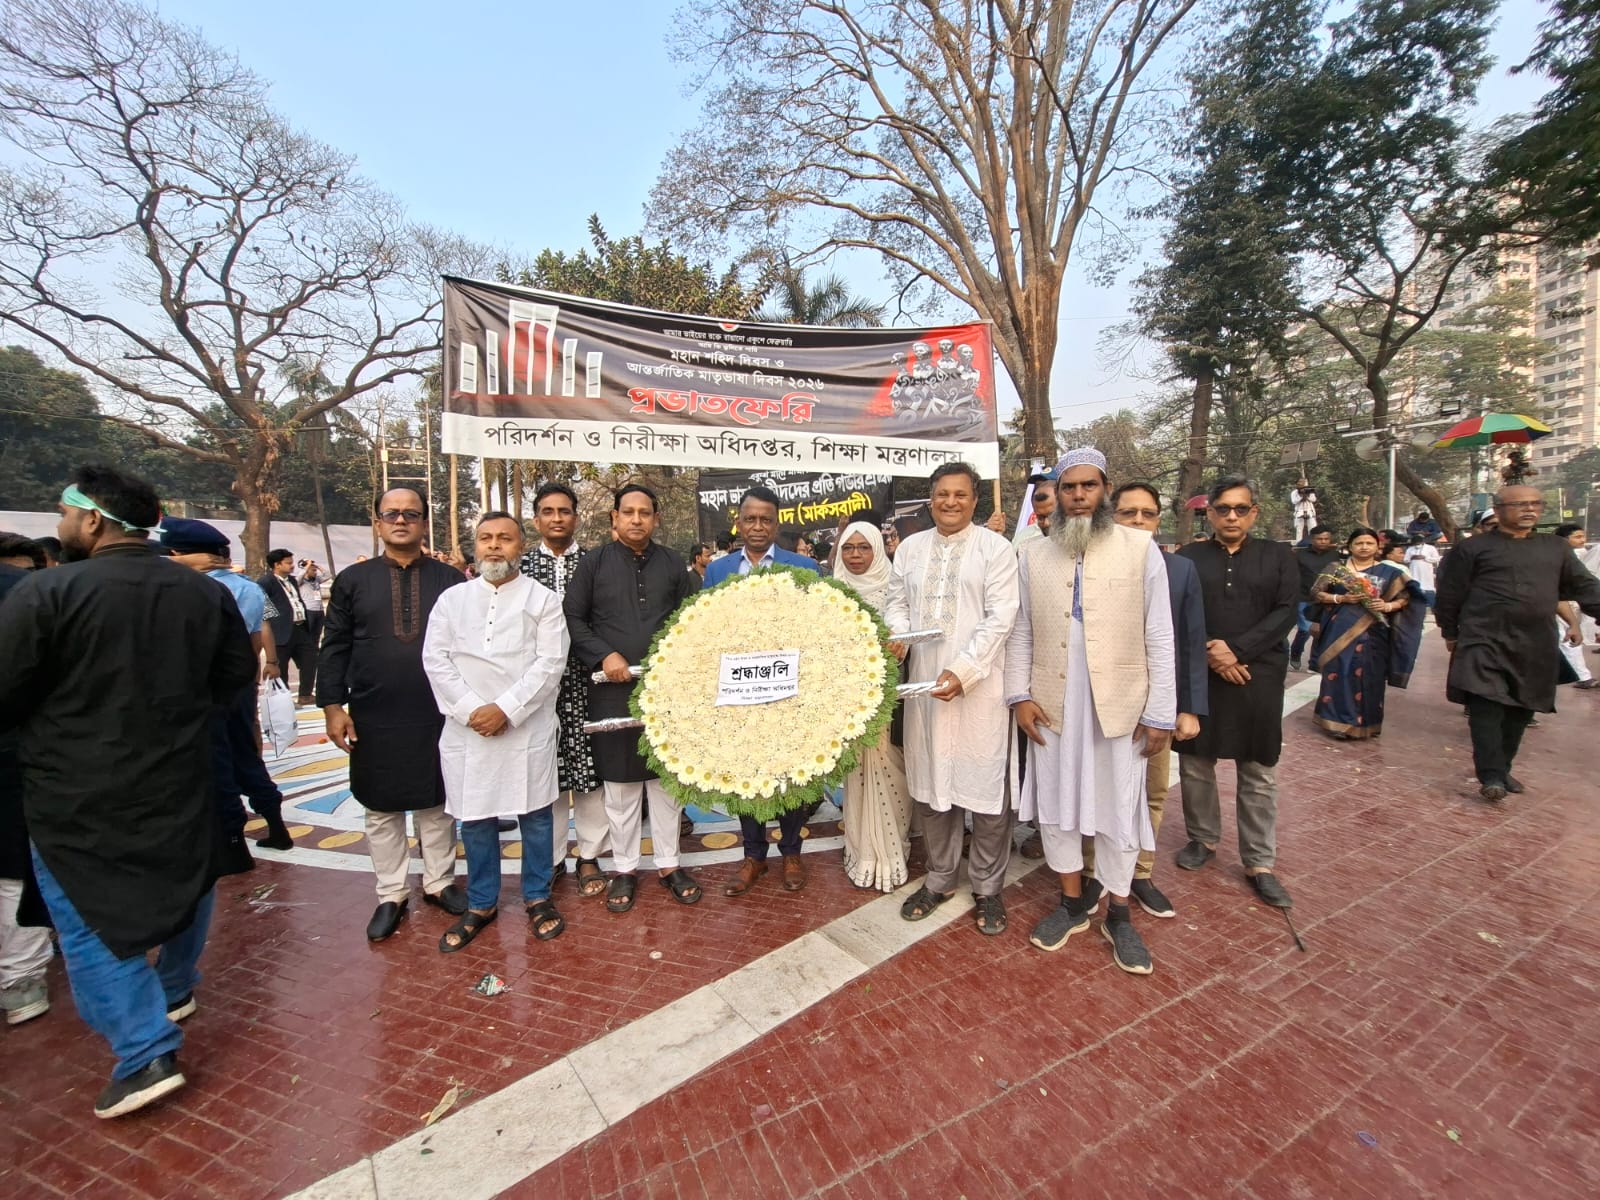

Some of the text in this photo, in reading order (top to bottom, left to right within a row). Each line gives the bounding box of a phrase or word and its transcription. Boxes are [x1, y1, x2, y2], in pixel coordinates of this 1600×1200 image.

[670, 349, 784, 368] মহান শহিদ দিবস ও
[626, 362, 825, 390] আন্তর্জাতিক মাতৃভাষা দিবস ২০২৬
[627, 387, 820, 425] প্রভাতফেরি
[484, 421, 575, 448] পরিদর্শন
[583, 430, 601, 447] ও
[610, 425, 690, 453] নিরীক্ষা
[696, 430, 802, 462] অধিদপ্তর,
[811, 436, 868, 463] শিক্ষা
[698, 488, 728, 511] মহান
[729, 485, 752, 504] ভা
[811, 473, 835, 496] প্রতি
[797, 491, 872, 525] (মার্কসবাদী)
[731, 660, 789, 680] শ্রদ্ধাঞ্জলি
